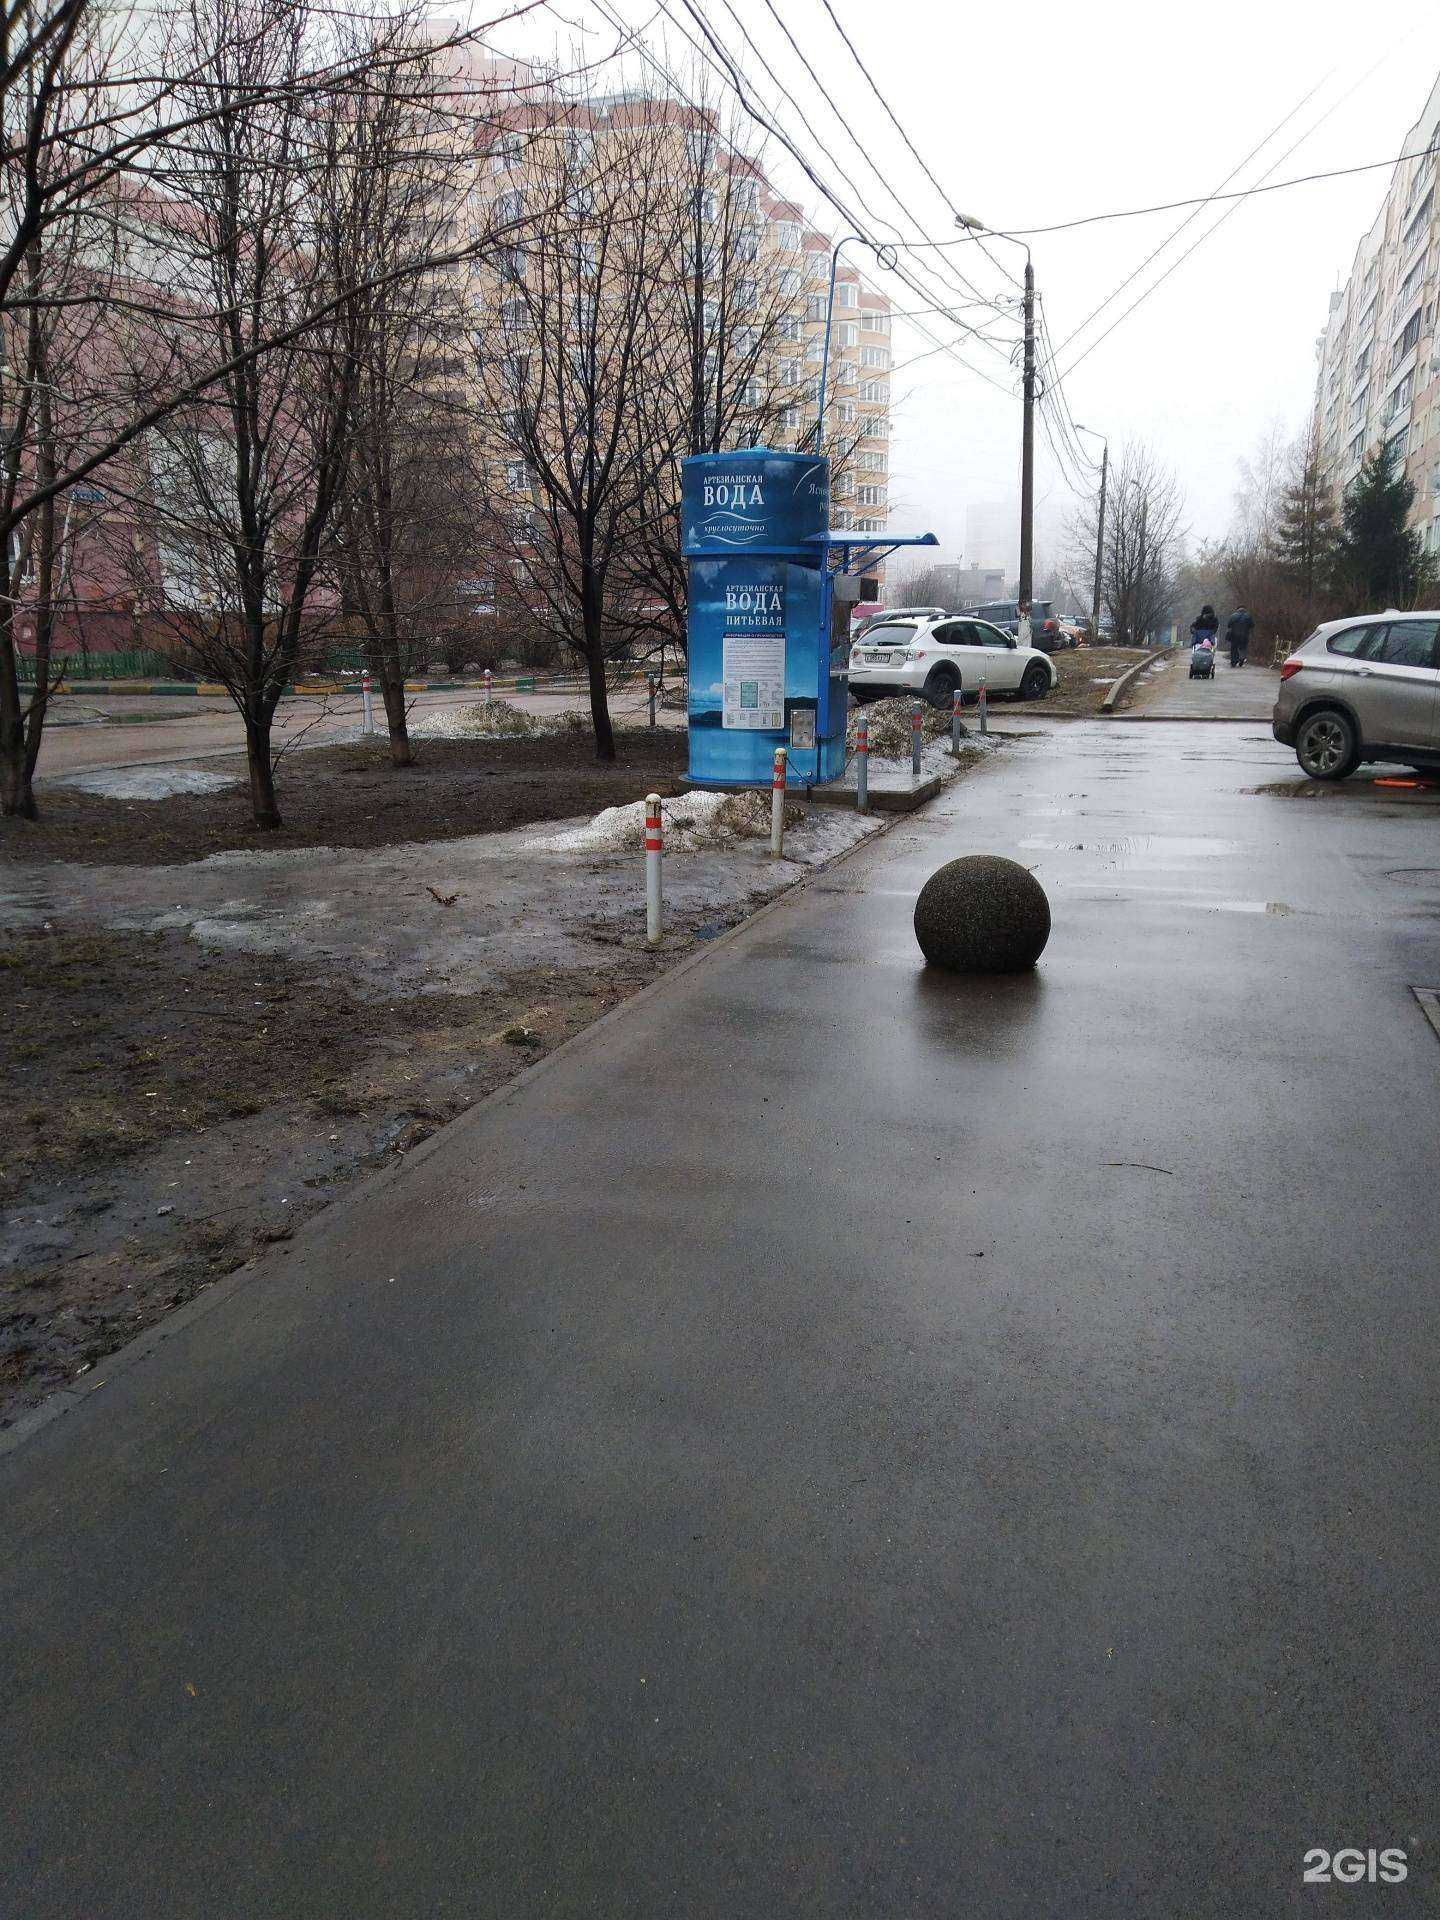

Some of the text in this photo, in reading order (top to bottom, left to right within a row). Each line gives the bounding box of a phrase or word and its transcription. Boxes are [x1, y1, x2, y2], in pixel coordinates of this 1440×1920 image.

[704, 475, 763, 485] АРТЕЗИАНСКАЯ
[704, 485, 765, 510] ВОДА
[726, 592, 782, 614] ВОДА
[726, 616, 782, 626] ПИТЬЕВАЯ
